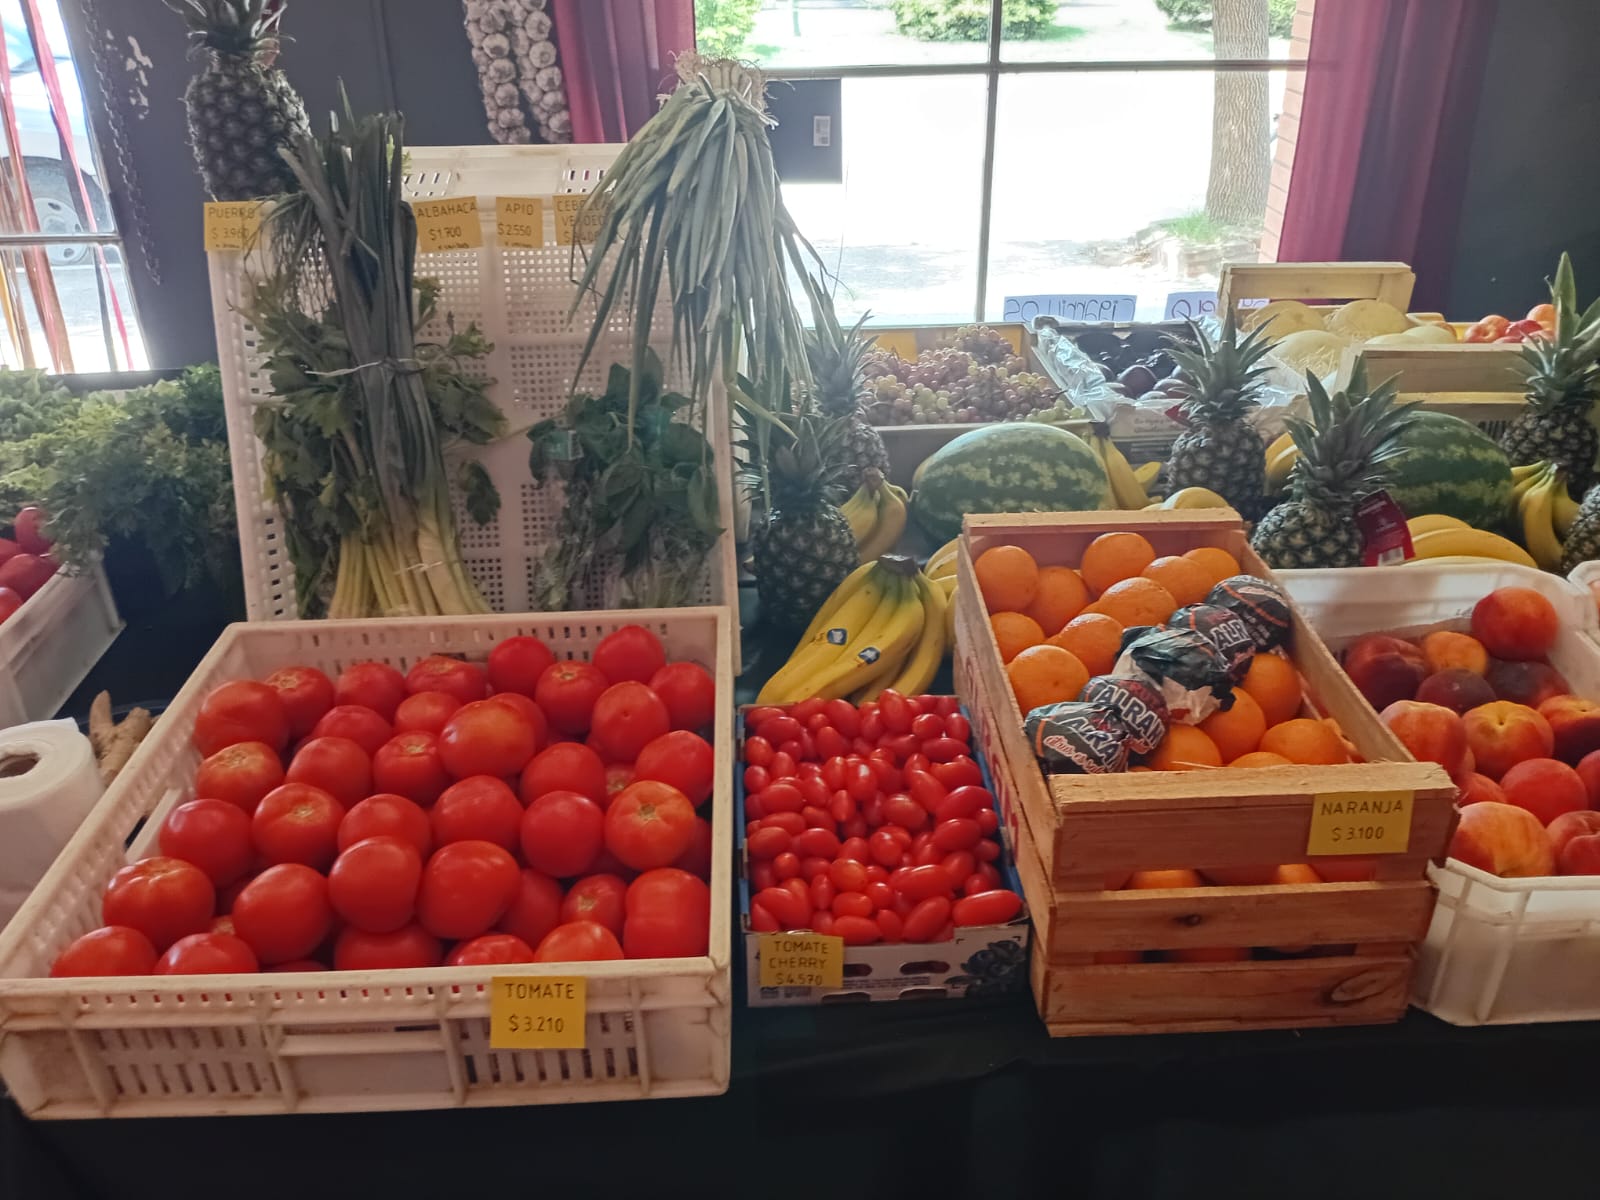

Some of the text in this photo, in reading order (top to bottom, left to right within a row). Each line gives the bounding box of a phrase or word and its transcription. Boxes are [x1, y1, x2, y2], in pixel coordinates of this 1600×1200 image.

[208, 207, 255, 220] PUERRO
[417, 201, 478, 218] ALBAHACA
[504, 203, 535, 216] APIO
[1320, 800, 1403, 816] NARANJA
[773, 940, 829, 954] TOMATE
[768, 957, 827, 970] CHERRY
[505, 983, 575, 999] TOMATE
